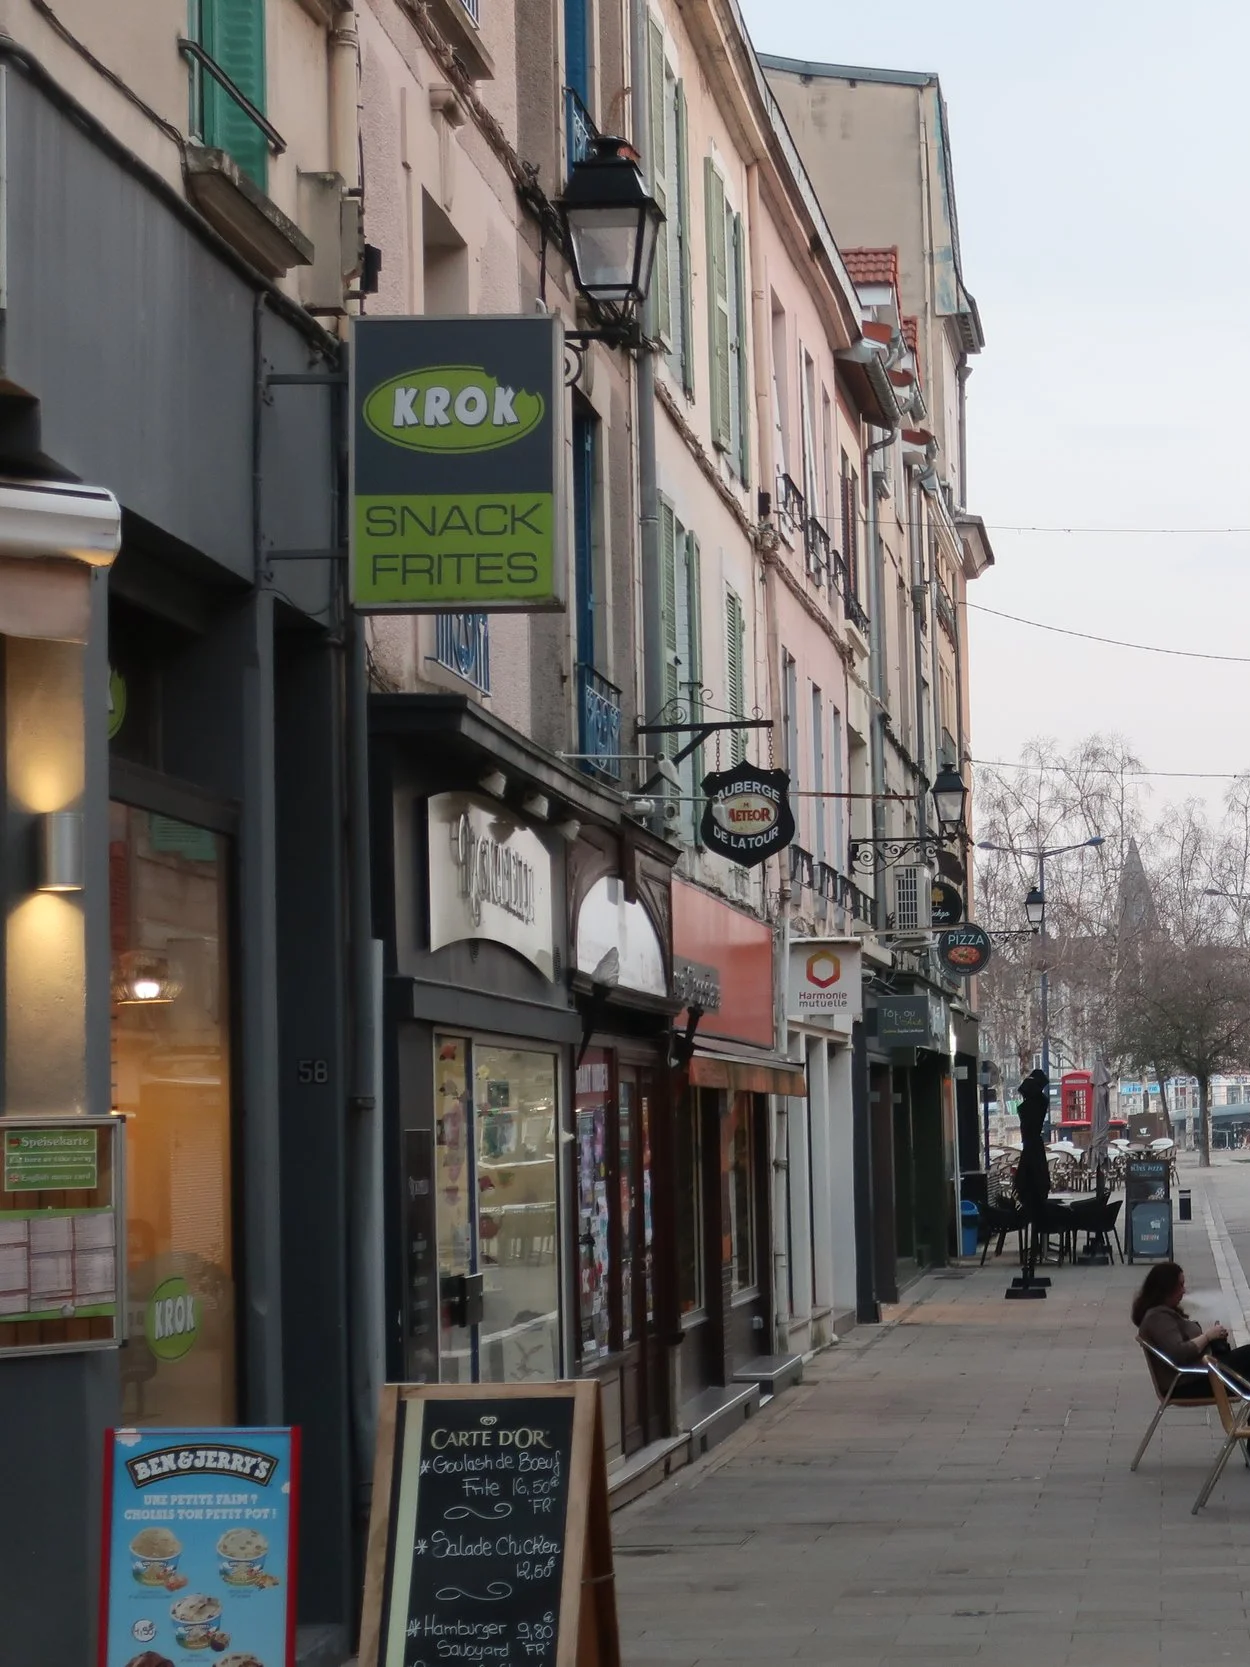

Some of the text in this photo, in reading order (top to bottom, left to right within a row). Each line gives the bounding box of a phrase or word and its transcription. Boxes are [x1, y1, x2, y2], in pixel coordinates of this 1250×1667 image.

[392, 385, 519, 427] KROK
[366, 503, 544, 537] SNACK
[372, 552, 538, 585] FRITES
[713, 781, 780, 803] AUBERGE
[714, 825, 779, 849] DE LA TOUR
[948, 935, 985, 945] PIZZA
[799, 992, 848, 1000] Harmonie
[799, 1000, 848, 1008] mutuelle
[299, 1060, 328, 1083] 58
[21, 1136, 90, 1148] Speisekarte
[154, 1294, 195, 1341] KROK
[431, 1427, 552, 1449] CARTE D'OR
[432, 1454, 493, 1474] Goulash
[495, 1452, 515, 1469] de
[462, 1477, 501, 1497] Frite
[170, 1494, 213, 1505] PETITE
[205, 1509, 243, 1519] PETIT
[245, 1508, 270, 1519] POT
[431, 1530, 561, 1558] Salade Chicken
[424, 1614, 507, 1640] Hamburger
